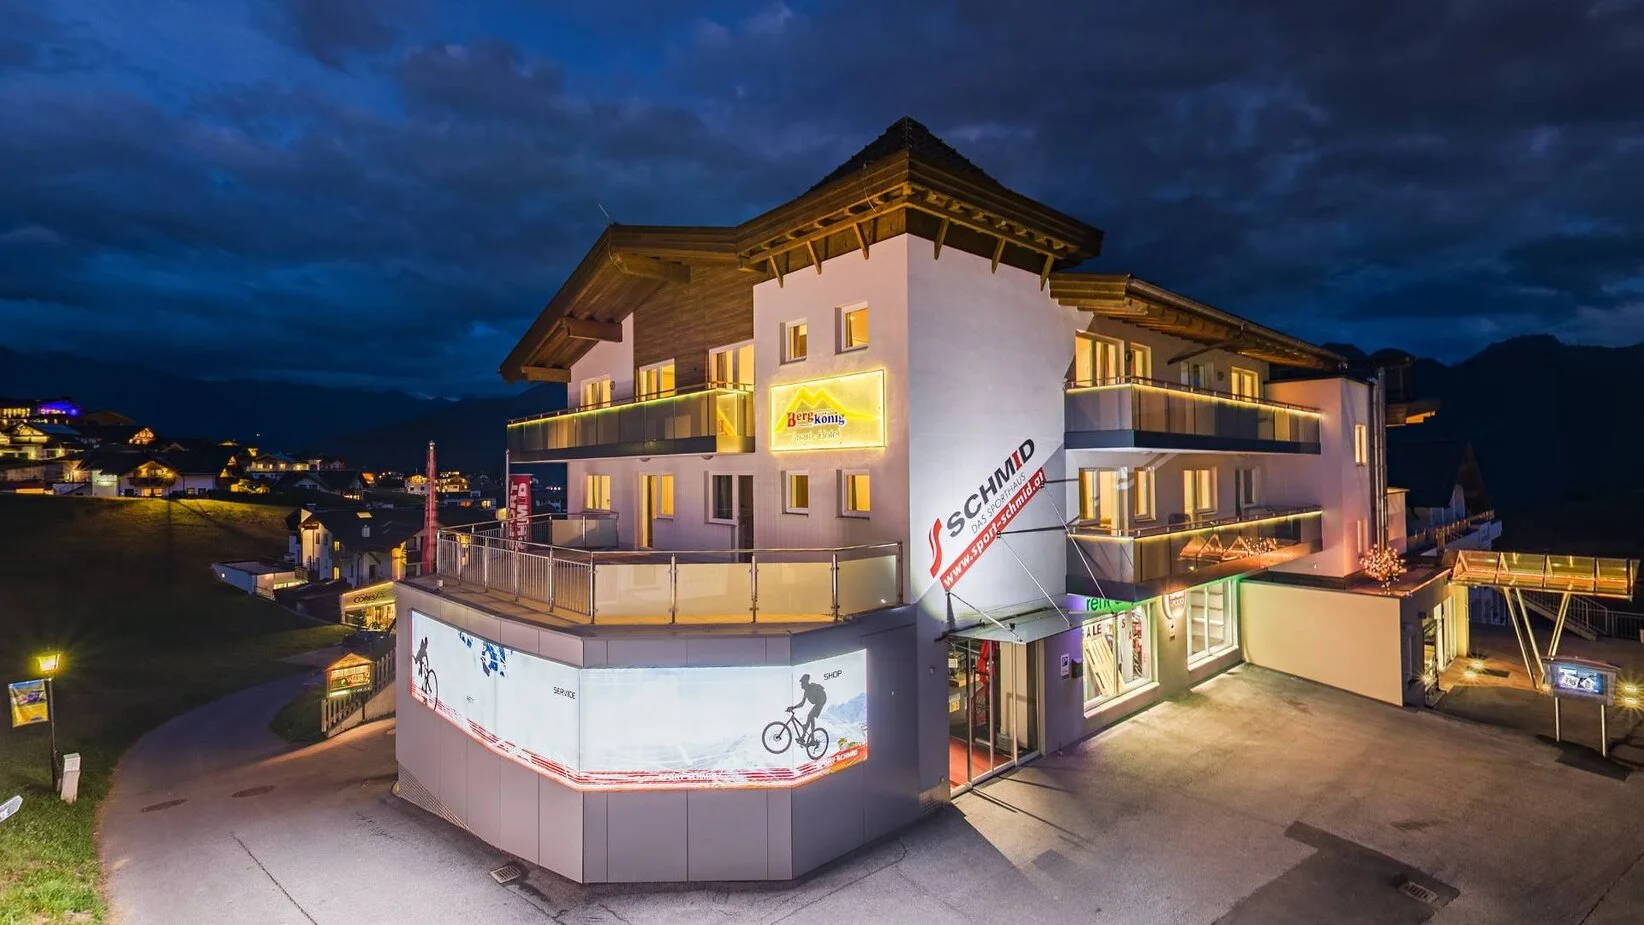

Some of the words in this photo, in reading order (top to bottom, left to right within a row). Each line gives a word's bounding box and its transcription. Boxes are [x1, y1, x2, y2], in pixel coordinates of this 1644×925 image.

[946, 438, 1035, 538] SCHMID
[987, 472, 1026, 517] SPORTHAUS
[943, 470, 1045, 588] www.sport-schmid.at
[971, 516, 987, 535] DAS
[824, 669, 843, 680] SHOP
[553, 686, 576, 700] SERVICE
